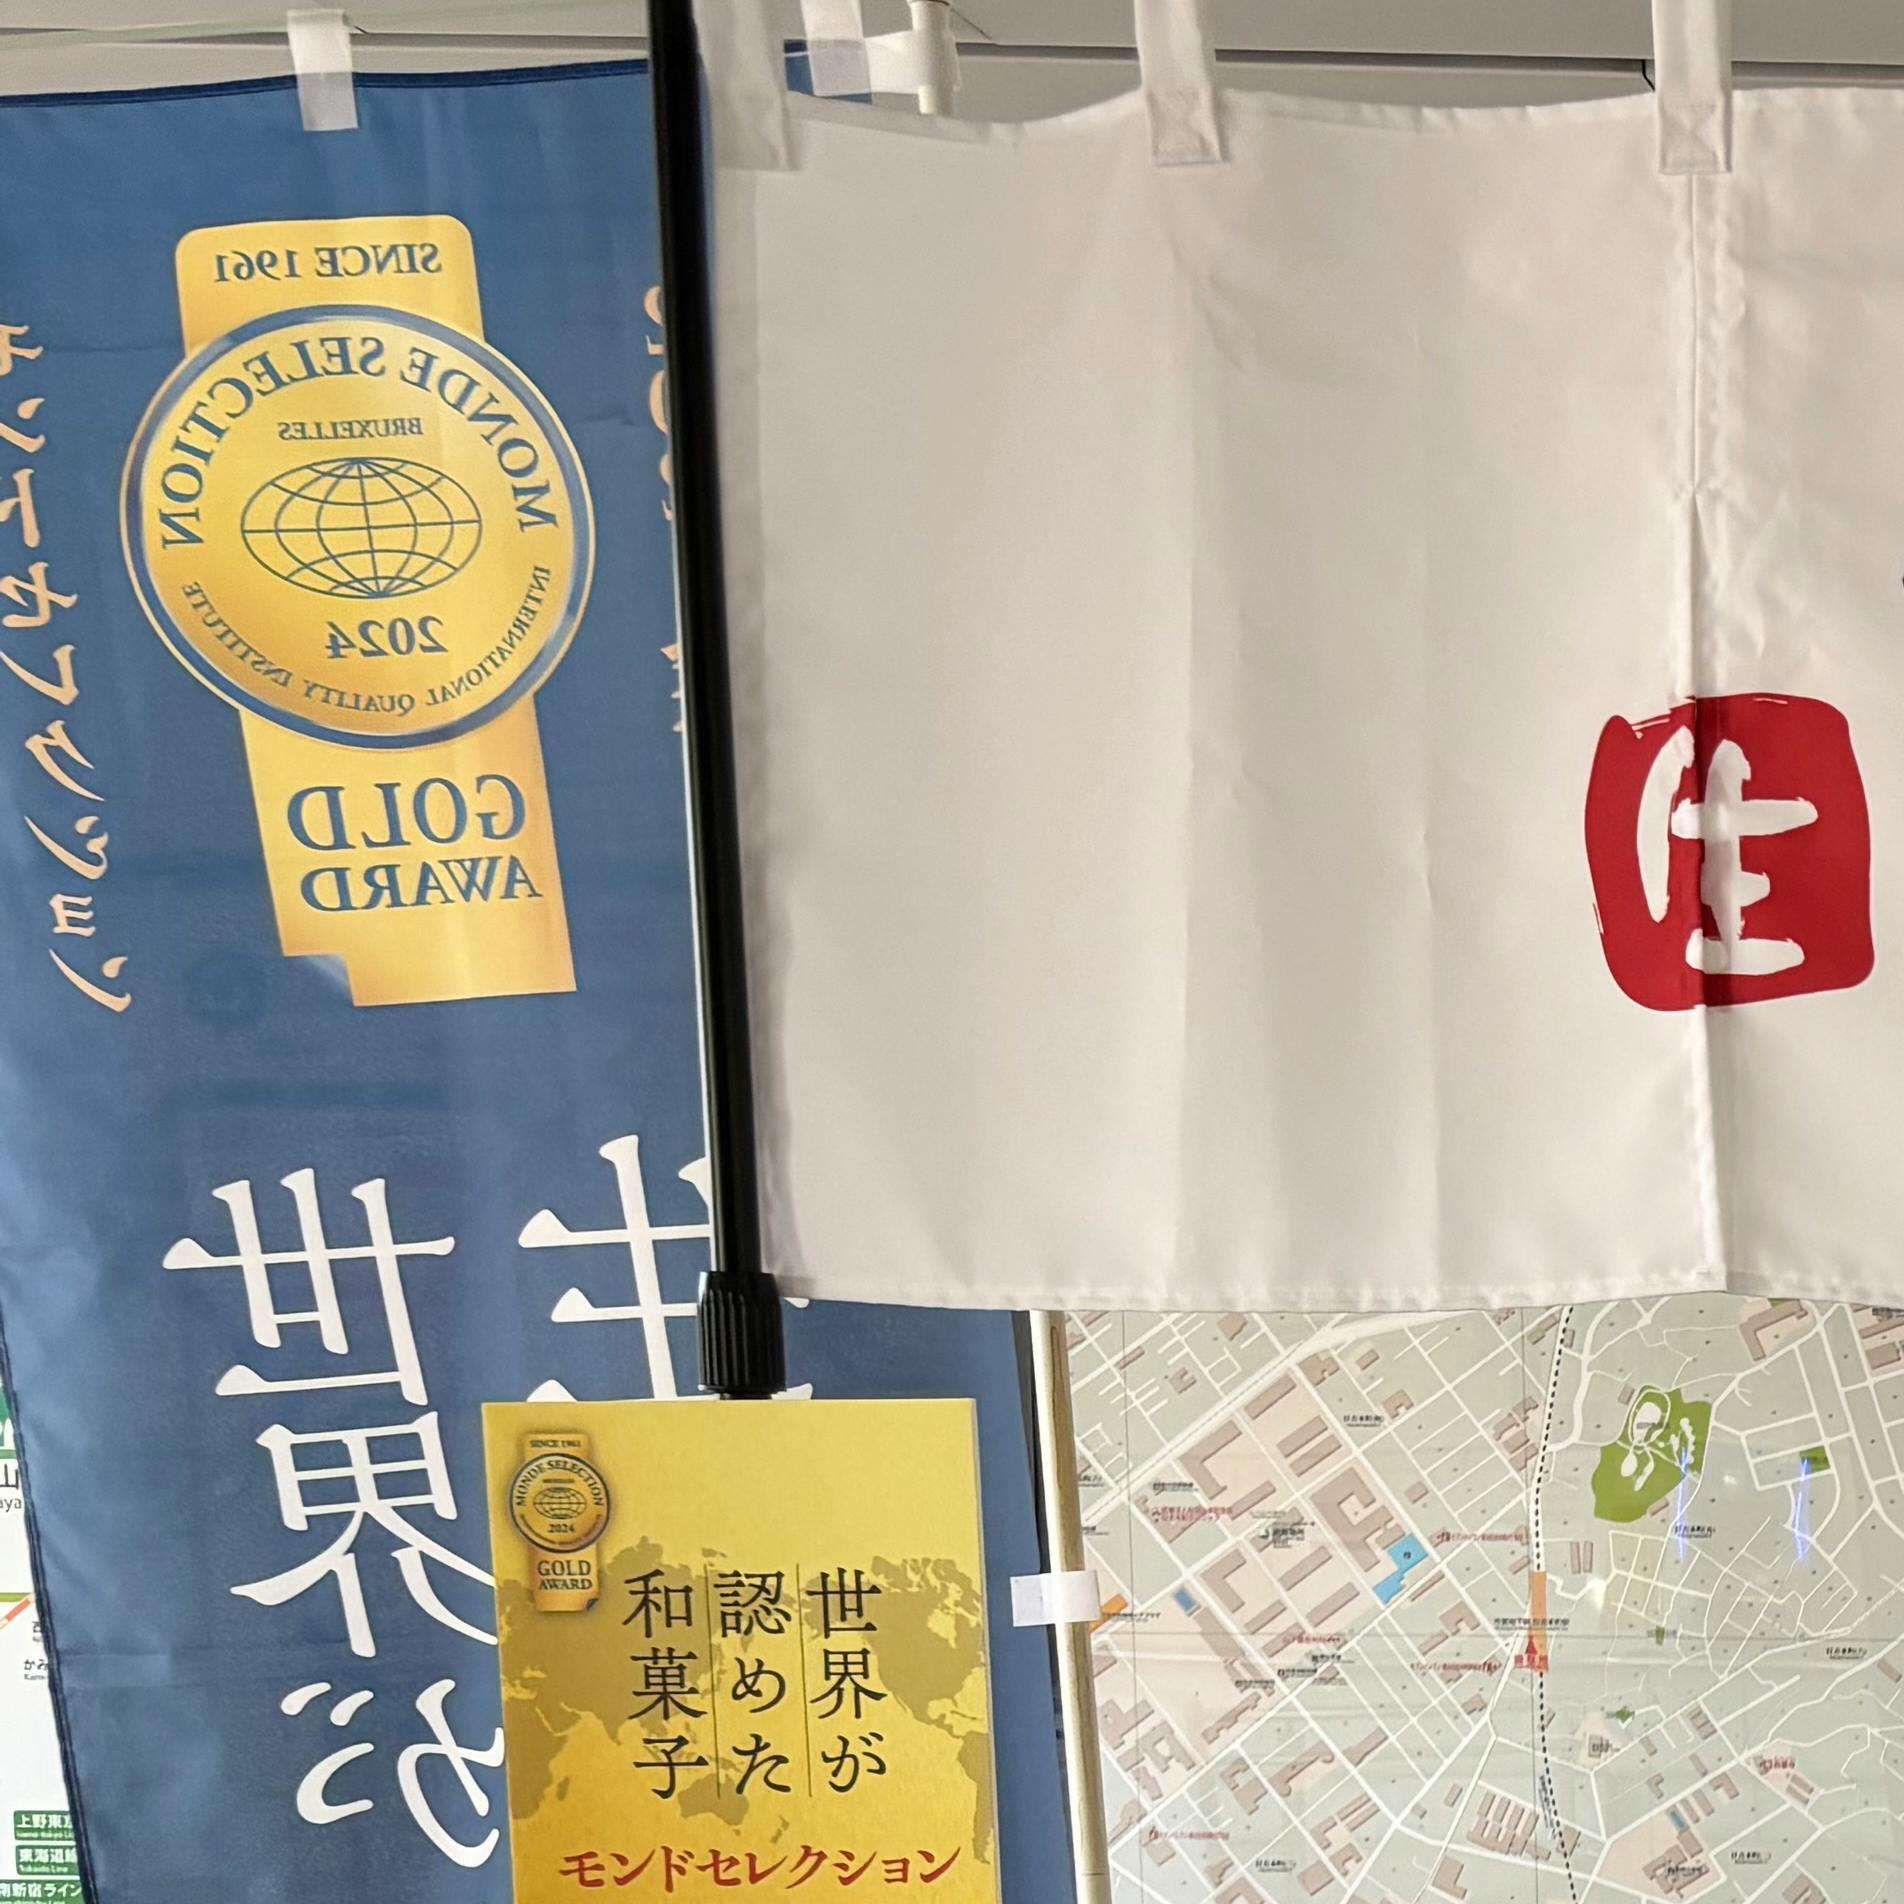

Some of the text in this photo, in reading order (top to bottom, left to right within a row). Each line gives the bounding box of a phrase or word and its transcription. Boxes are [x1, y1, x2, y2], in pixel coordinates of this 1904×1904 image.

[1638, 730, 1821, 980] 生
[516, 1460, 604, 1506] MONDE SELECTION
[548, 1524, 575, 1533] 2024
[538, 1560, 591, 1576] GOLD
[540, 1579, 592, 1590] AWARD
[623, 1568, 709, 1798] 和菓子
[714, 1571, 794, 1795] 認めた
[806, 1568, 888, 1792] 世界が
[557, 1845, 961, 1892] モンドセレクション
